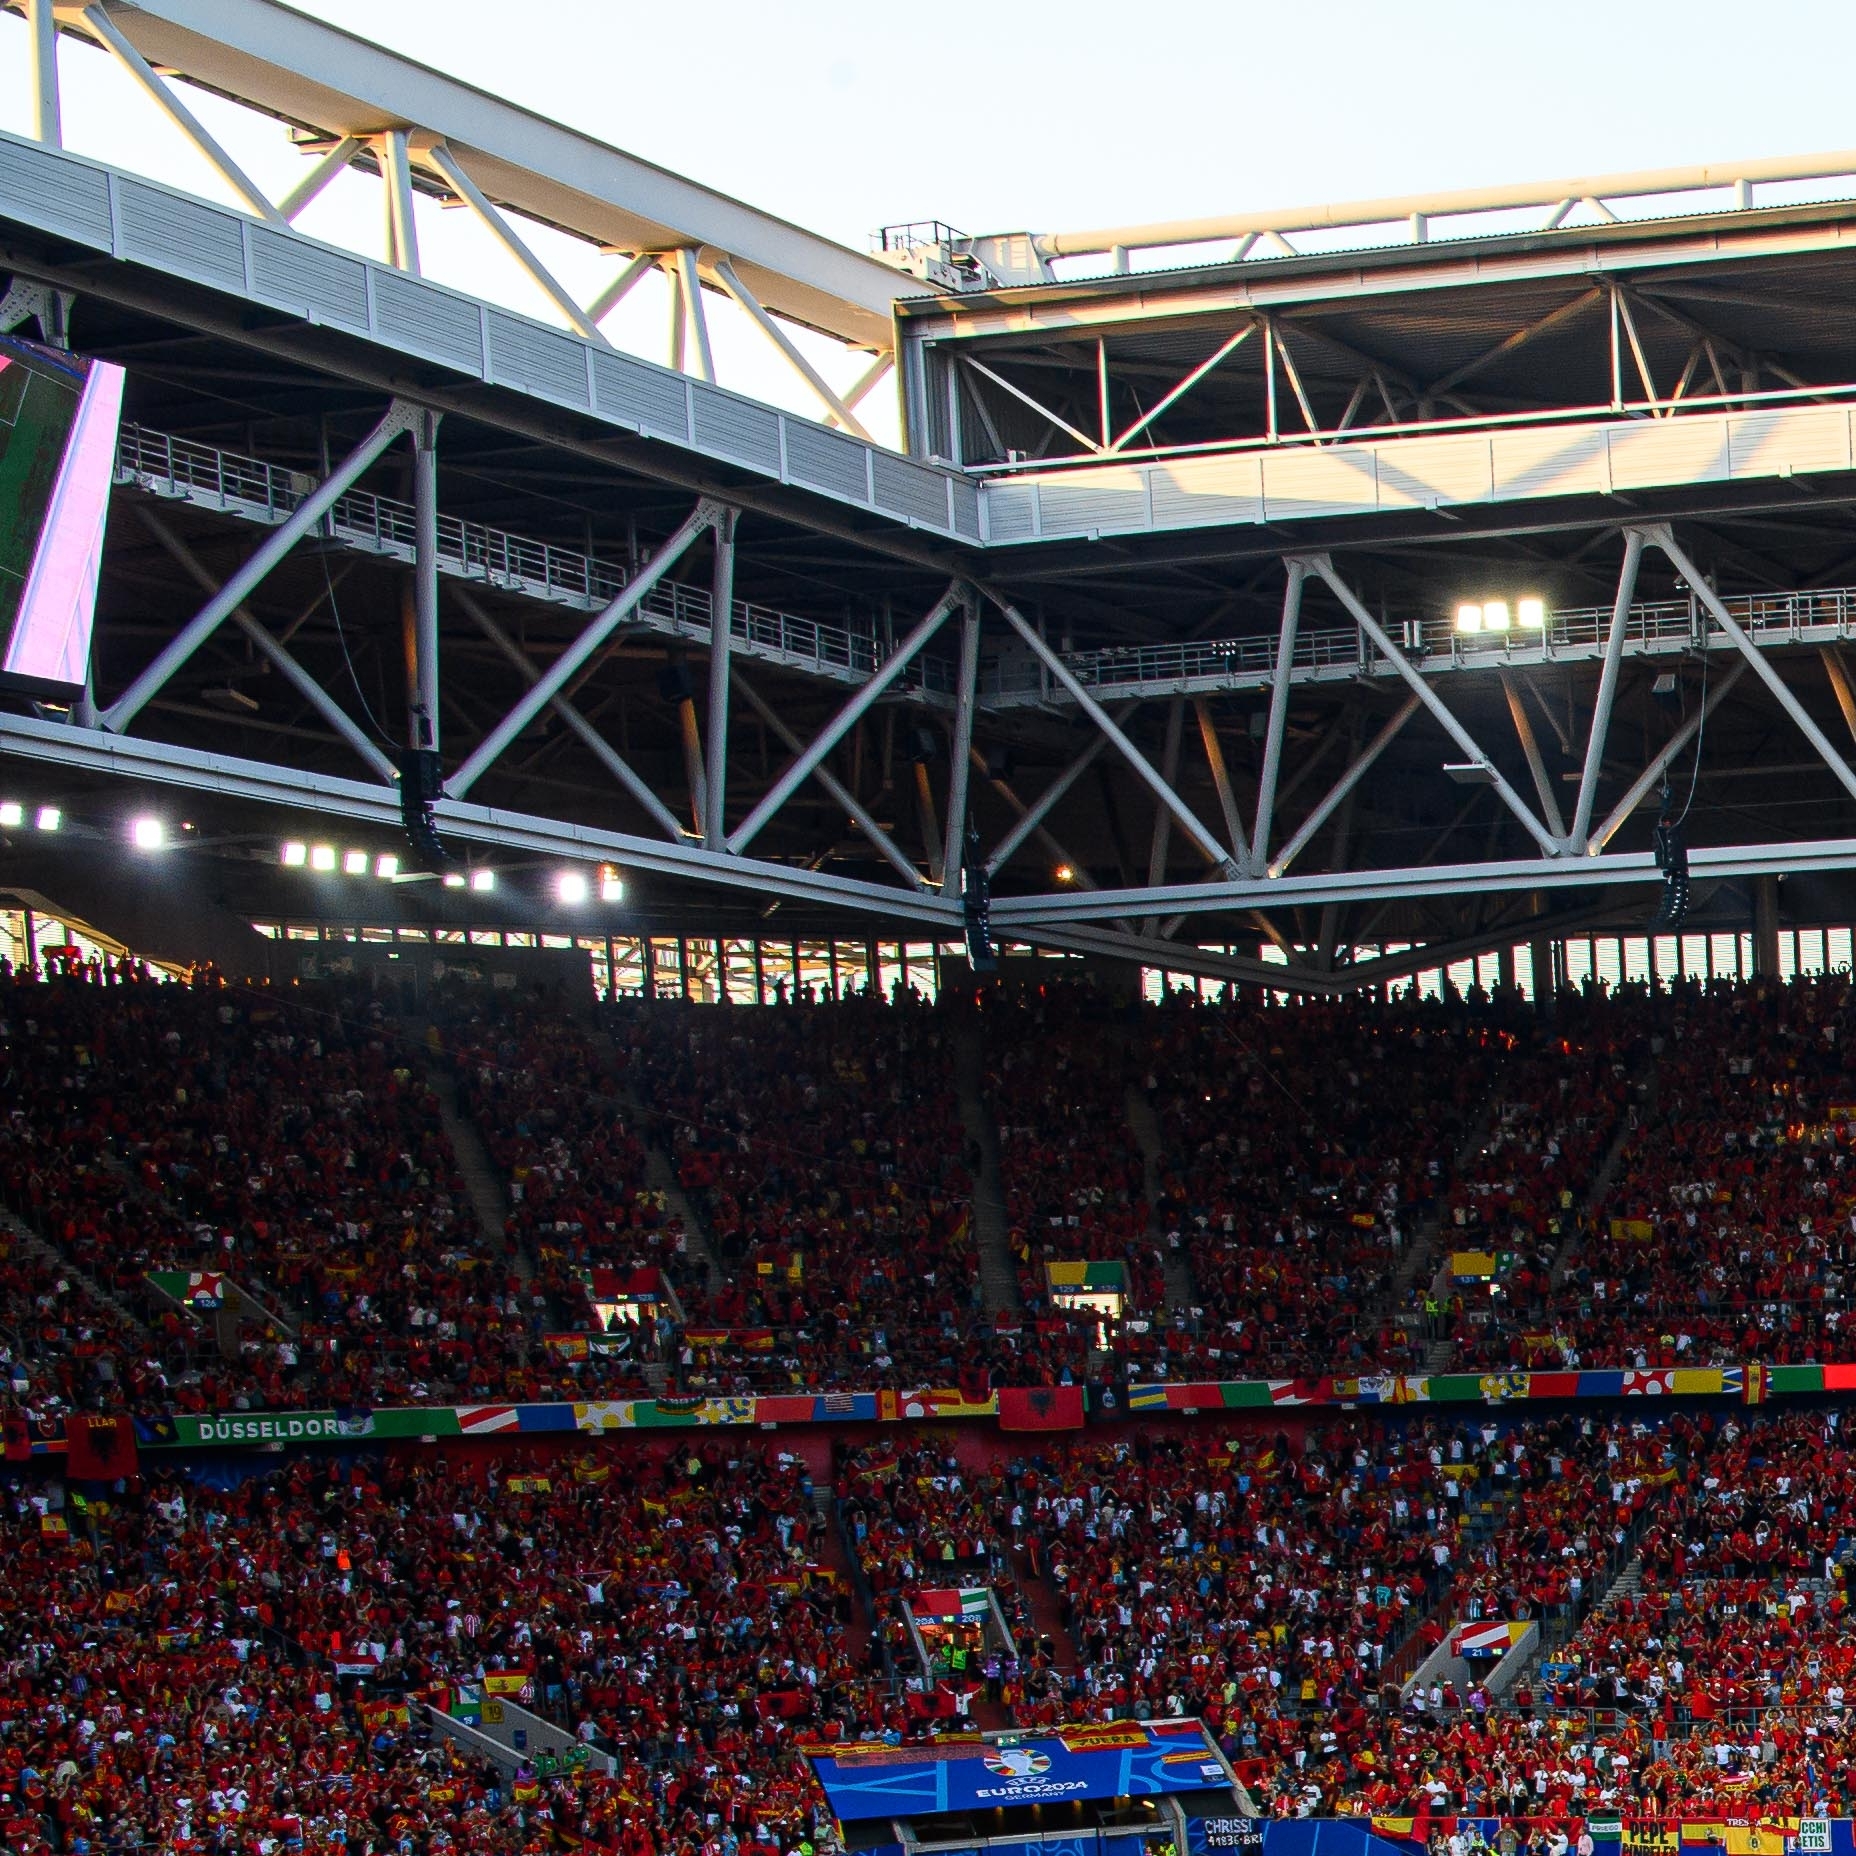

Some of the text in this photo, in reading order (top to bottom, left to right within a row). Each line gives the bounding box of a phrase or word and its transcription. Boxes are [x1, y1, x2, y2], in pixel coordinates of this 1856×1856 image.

[199, 1418, 344, 1442] DÜSSELDOR
[975, 1780, 1089, 1798] EURO2024
[1205, 1818, 1253, 1835] CHRISSI
[1629, 1821, 1669, 1845] PEPE
